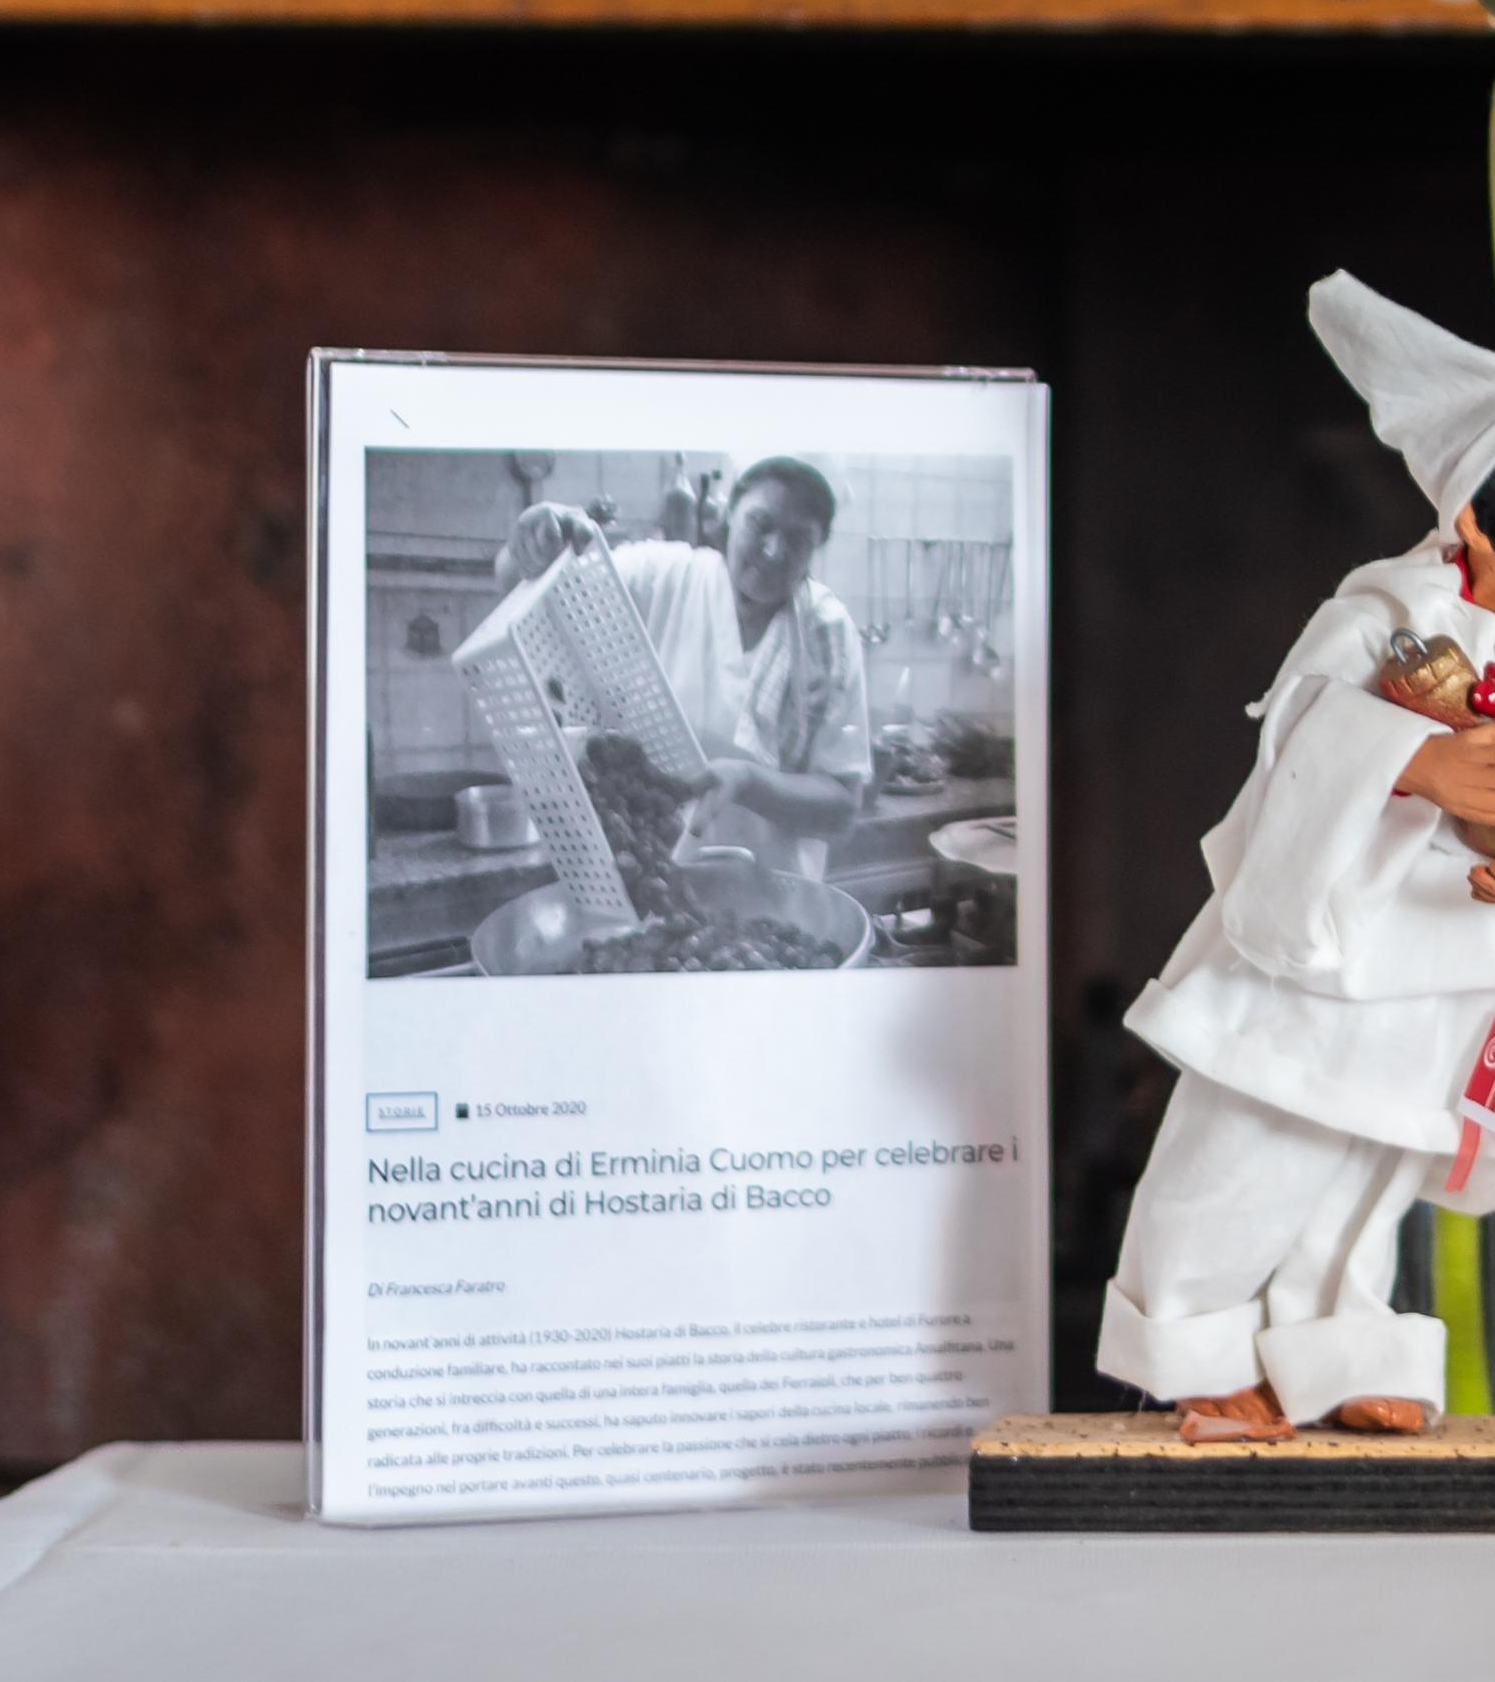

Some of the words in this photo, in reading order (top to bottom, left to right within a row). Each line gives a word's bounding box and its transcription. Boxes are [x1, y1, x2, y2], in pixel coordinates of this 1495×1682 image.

[476, 1103, 492, 1118] 15
[495, 1101, 549, 1117] Ottobre
[551, 1099, 588, 1116] 2020
[368, 1155, 441, 1184] Nella
[450, 1152, 546, 1181] cucina
[555, 1150, 581, 1177] di
[591, 1146, 700, 1176] Erminia
[709, 1146, 812, 1173] Cuomo
[821, 1148, 866, 1173] per
[875, 1139, 1004, 1166] celebrare
[1013, 1134, 1019, 1161] i
[368, 1192, 540, 1224] novant'anni
[548, 1190, 575, 1217] di
[585, 1185, 703, 1216] Hostaria
[711, 1182, 736, 1211] di
[746, 1182, 832, 1209] Bacco
